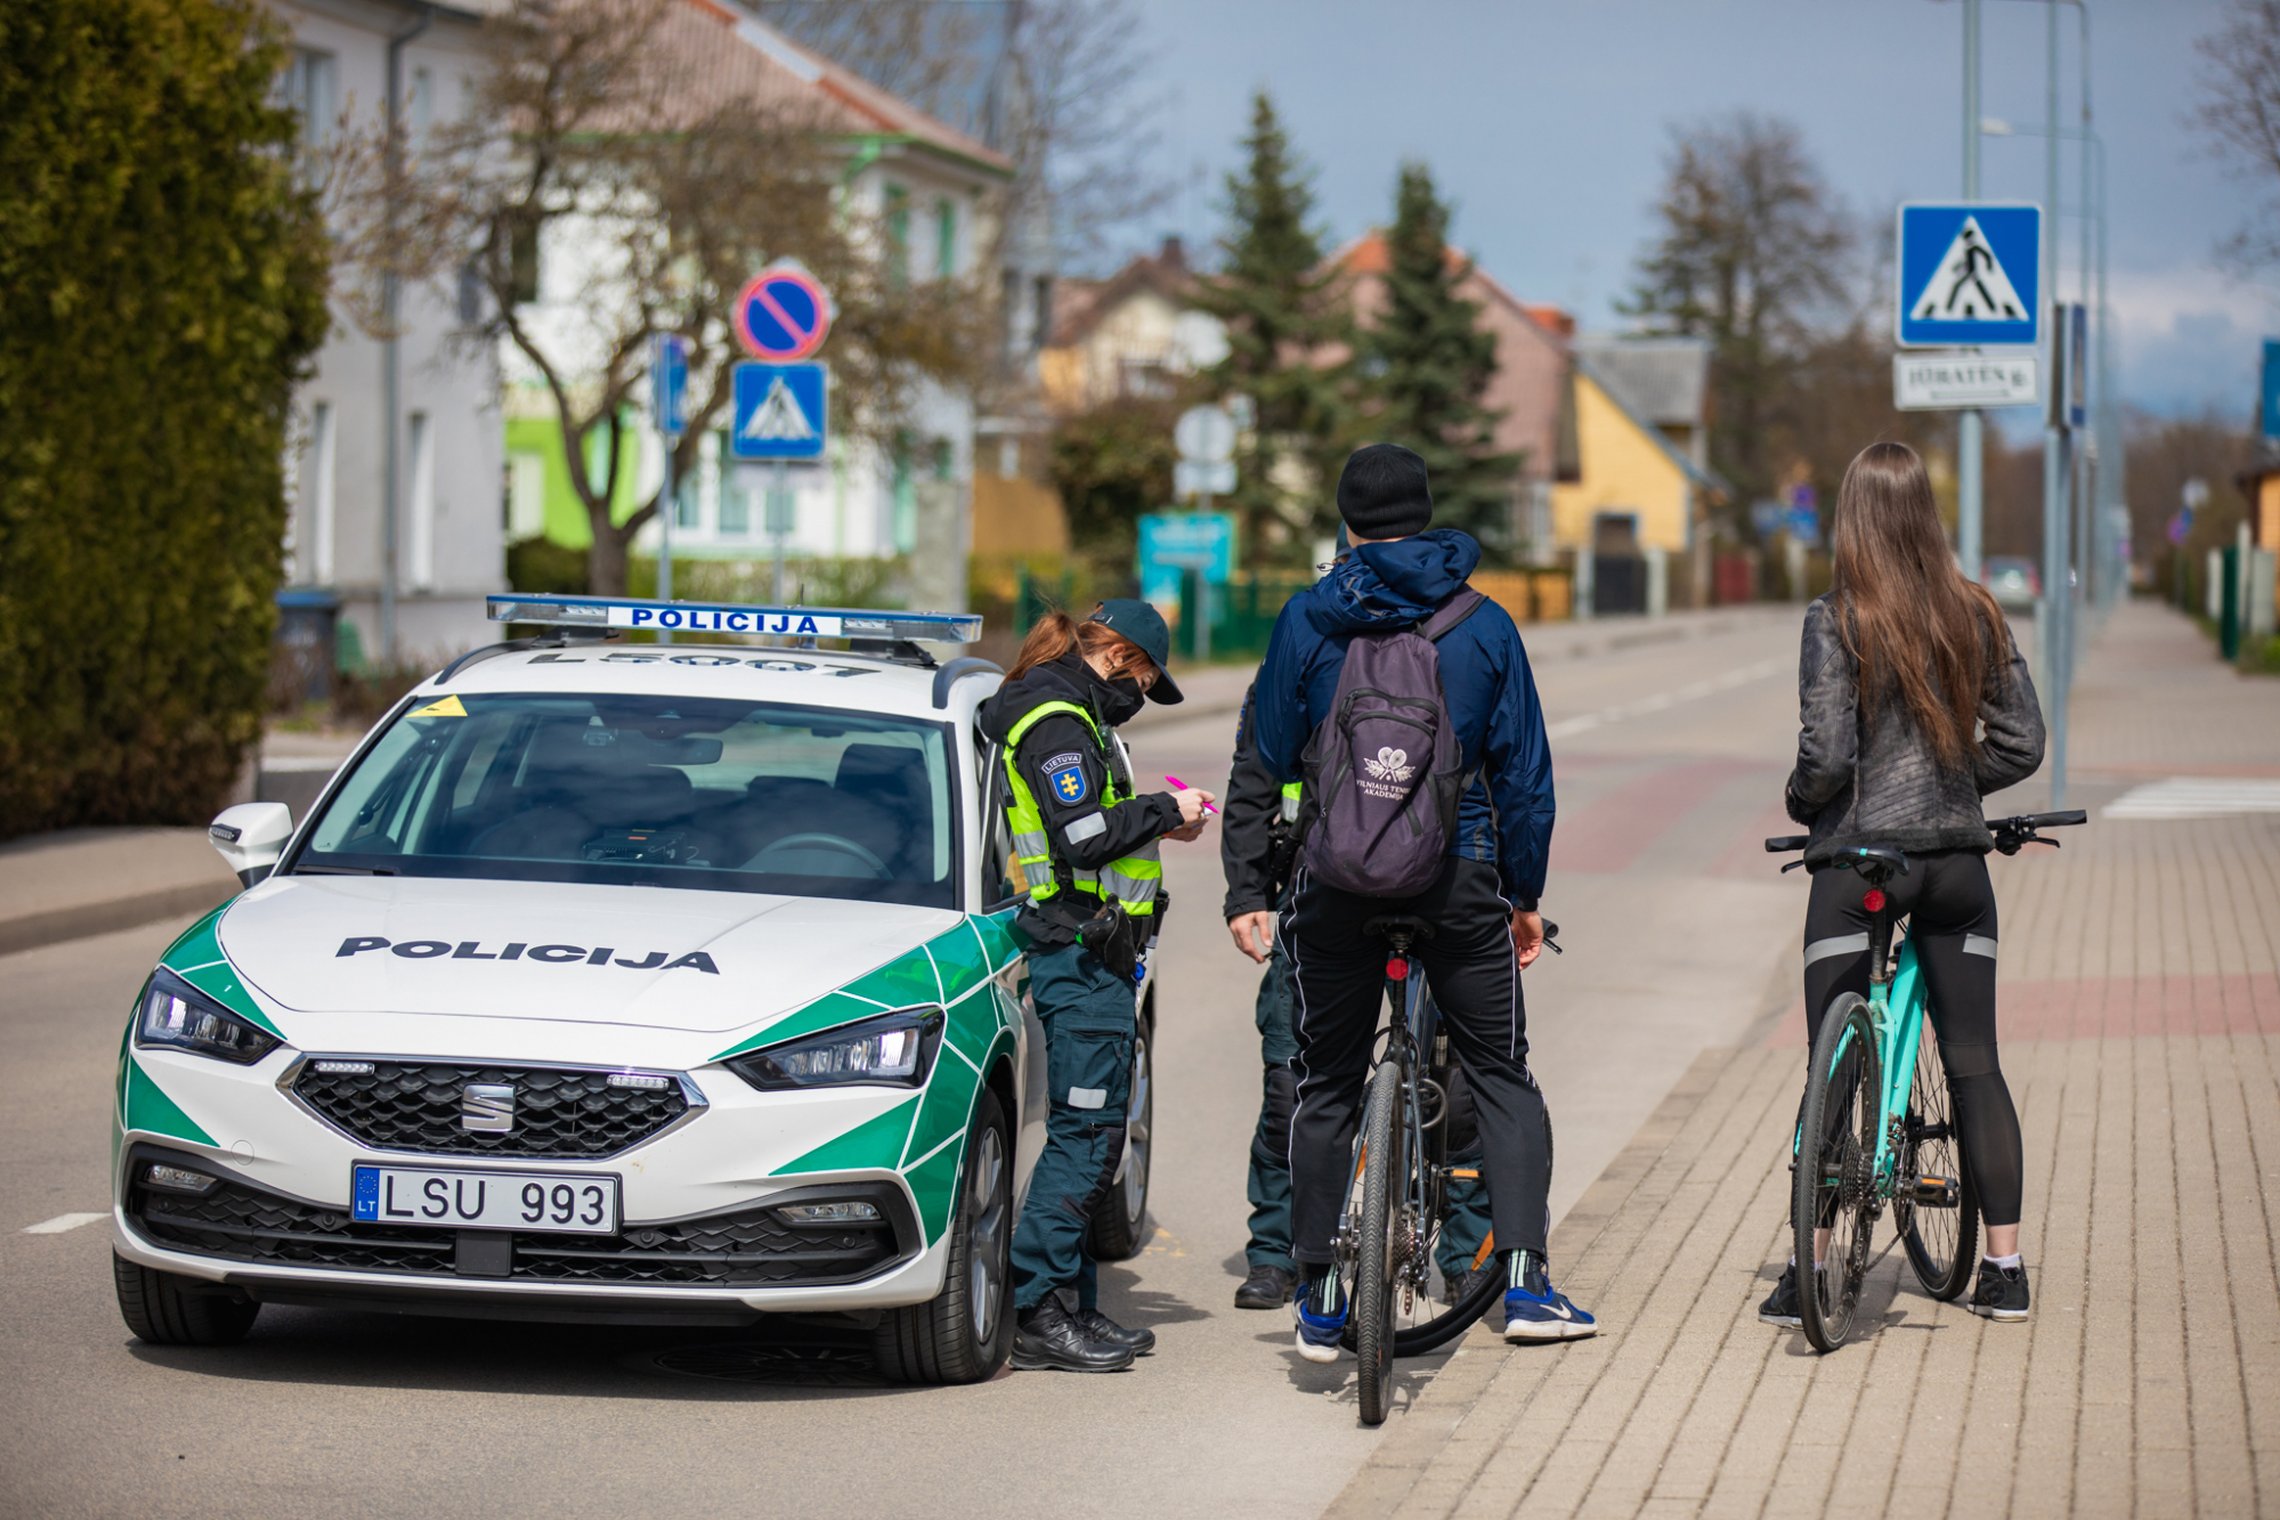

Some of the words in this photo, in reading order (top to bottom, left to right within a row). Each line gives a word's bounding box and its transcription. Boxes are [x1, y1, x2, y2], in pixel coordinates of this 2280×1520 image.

[631, 608, 820, 635] POLICIJA
[1044, 755, 1079, 772] LIETUVA
[335, 936, 721, 976] POLICIJA
[357, 1200, 376, 1213] LT
[385, 1174, 486, 1221] LSU
[520, 1181, 606, 1226] 993
